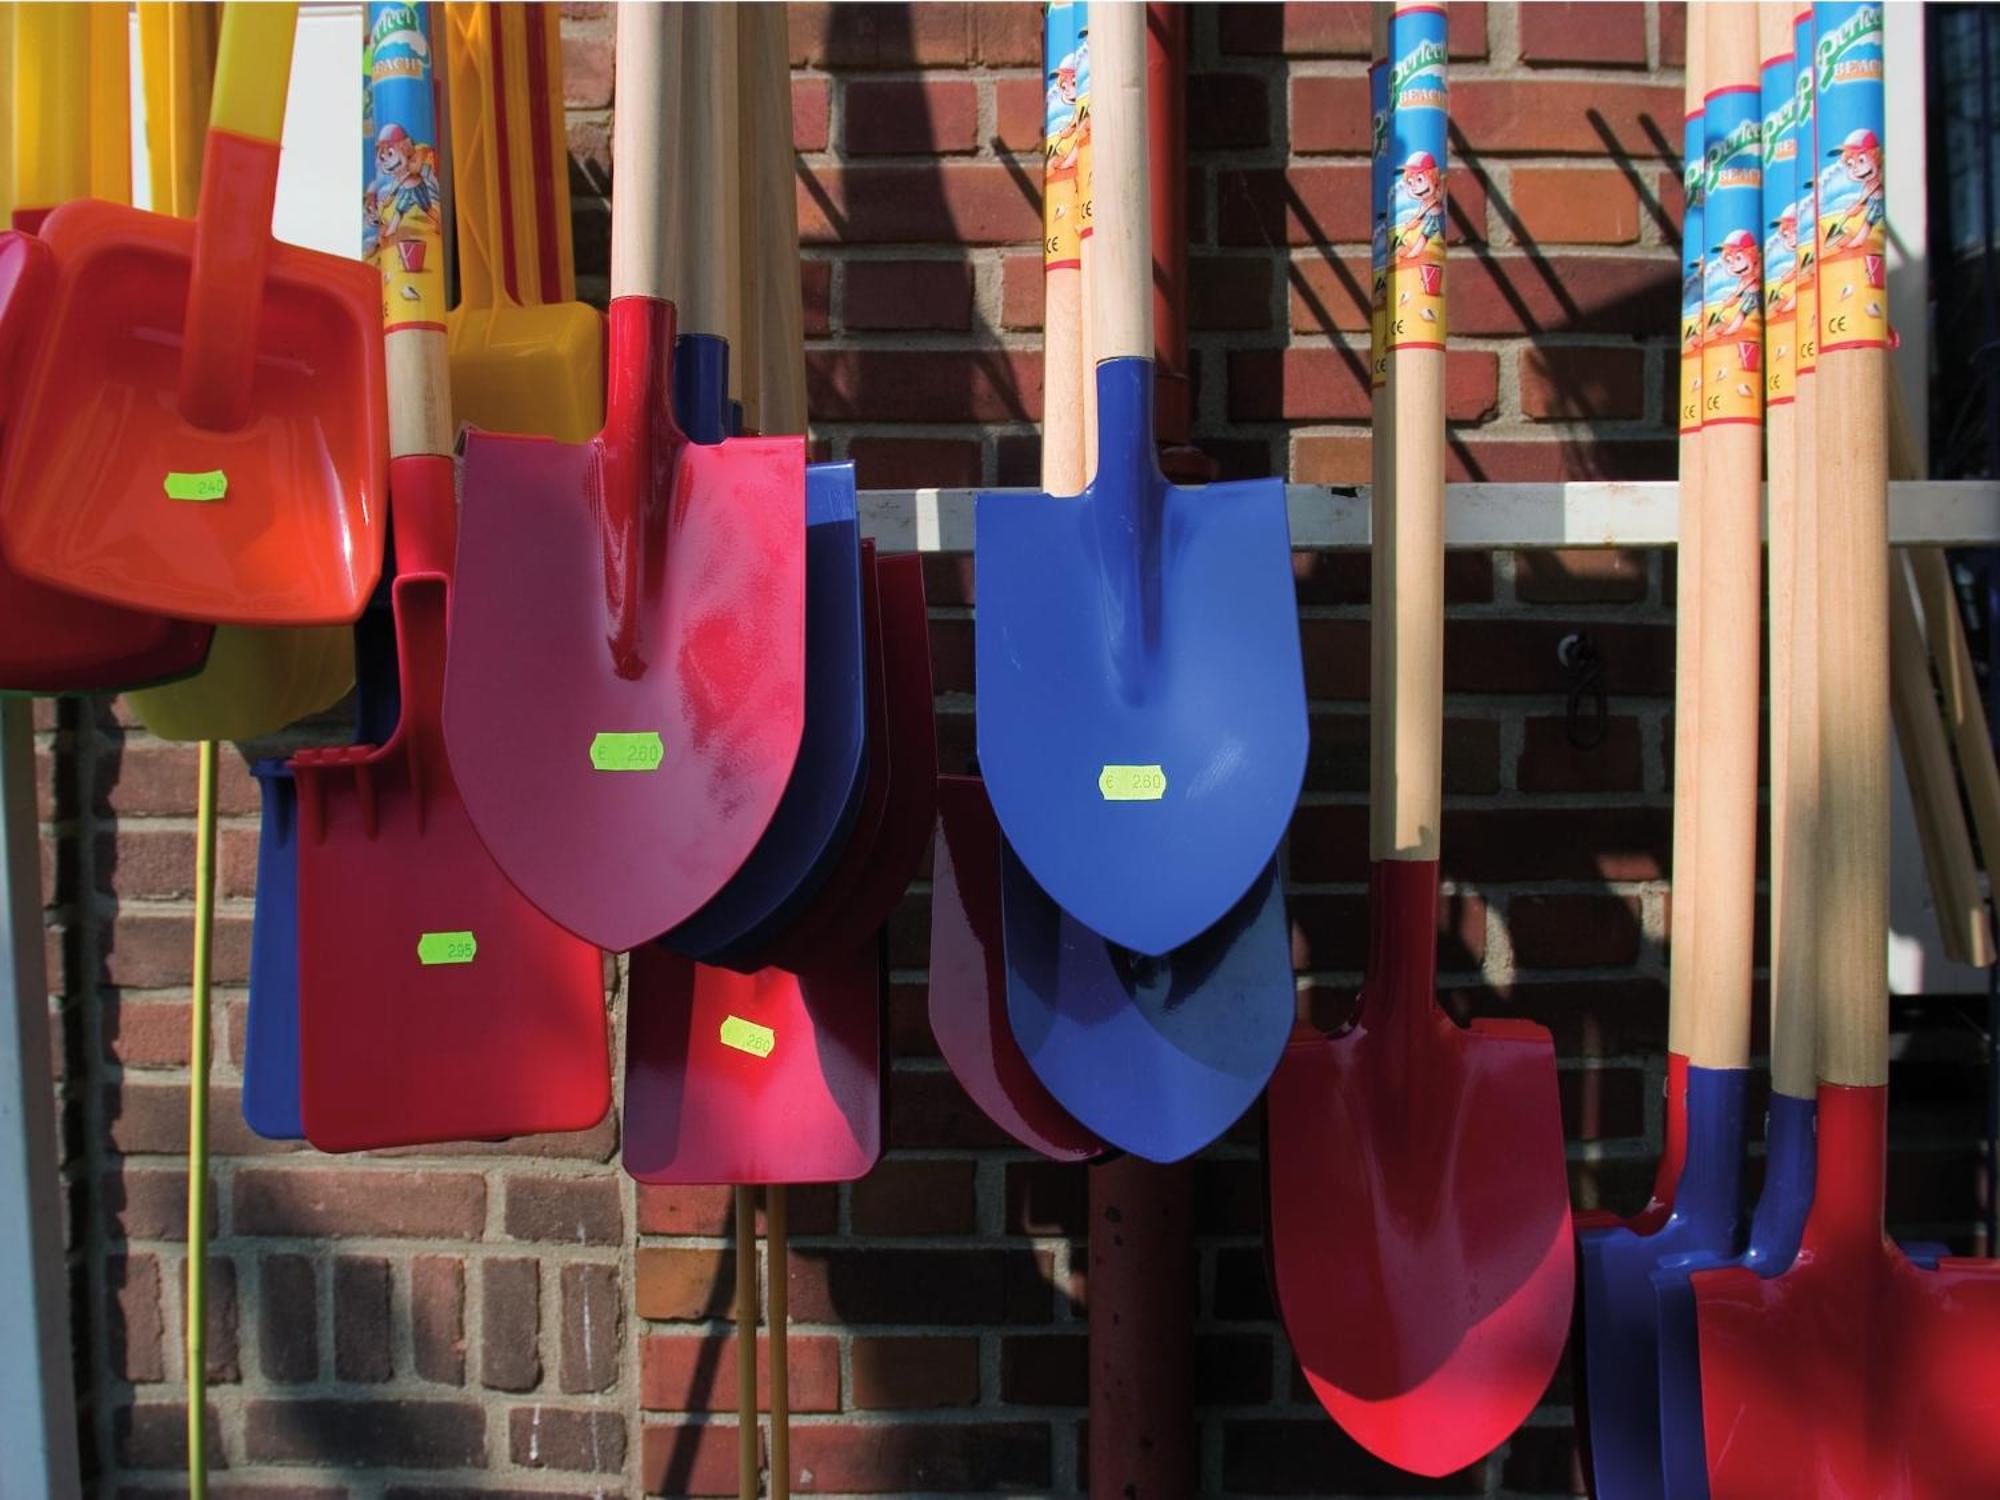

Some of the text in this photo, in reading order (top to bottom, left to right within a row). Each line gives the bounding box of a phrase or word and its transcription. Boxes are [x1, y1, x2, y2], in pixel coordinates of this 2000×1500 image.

[1391, 320, 1404, 336] CE
[1829, 316, 1847, 334] CE
[1800, 342, 1815, 359] CE
[1684, 404, 1696, 420] CE
[1707, 395, 1721, 412] CE
